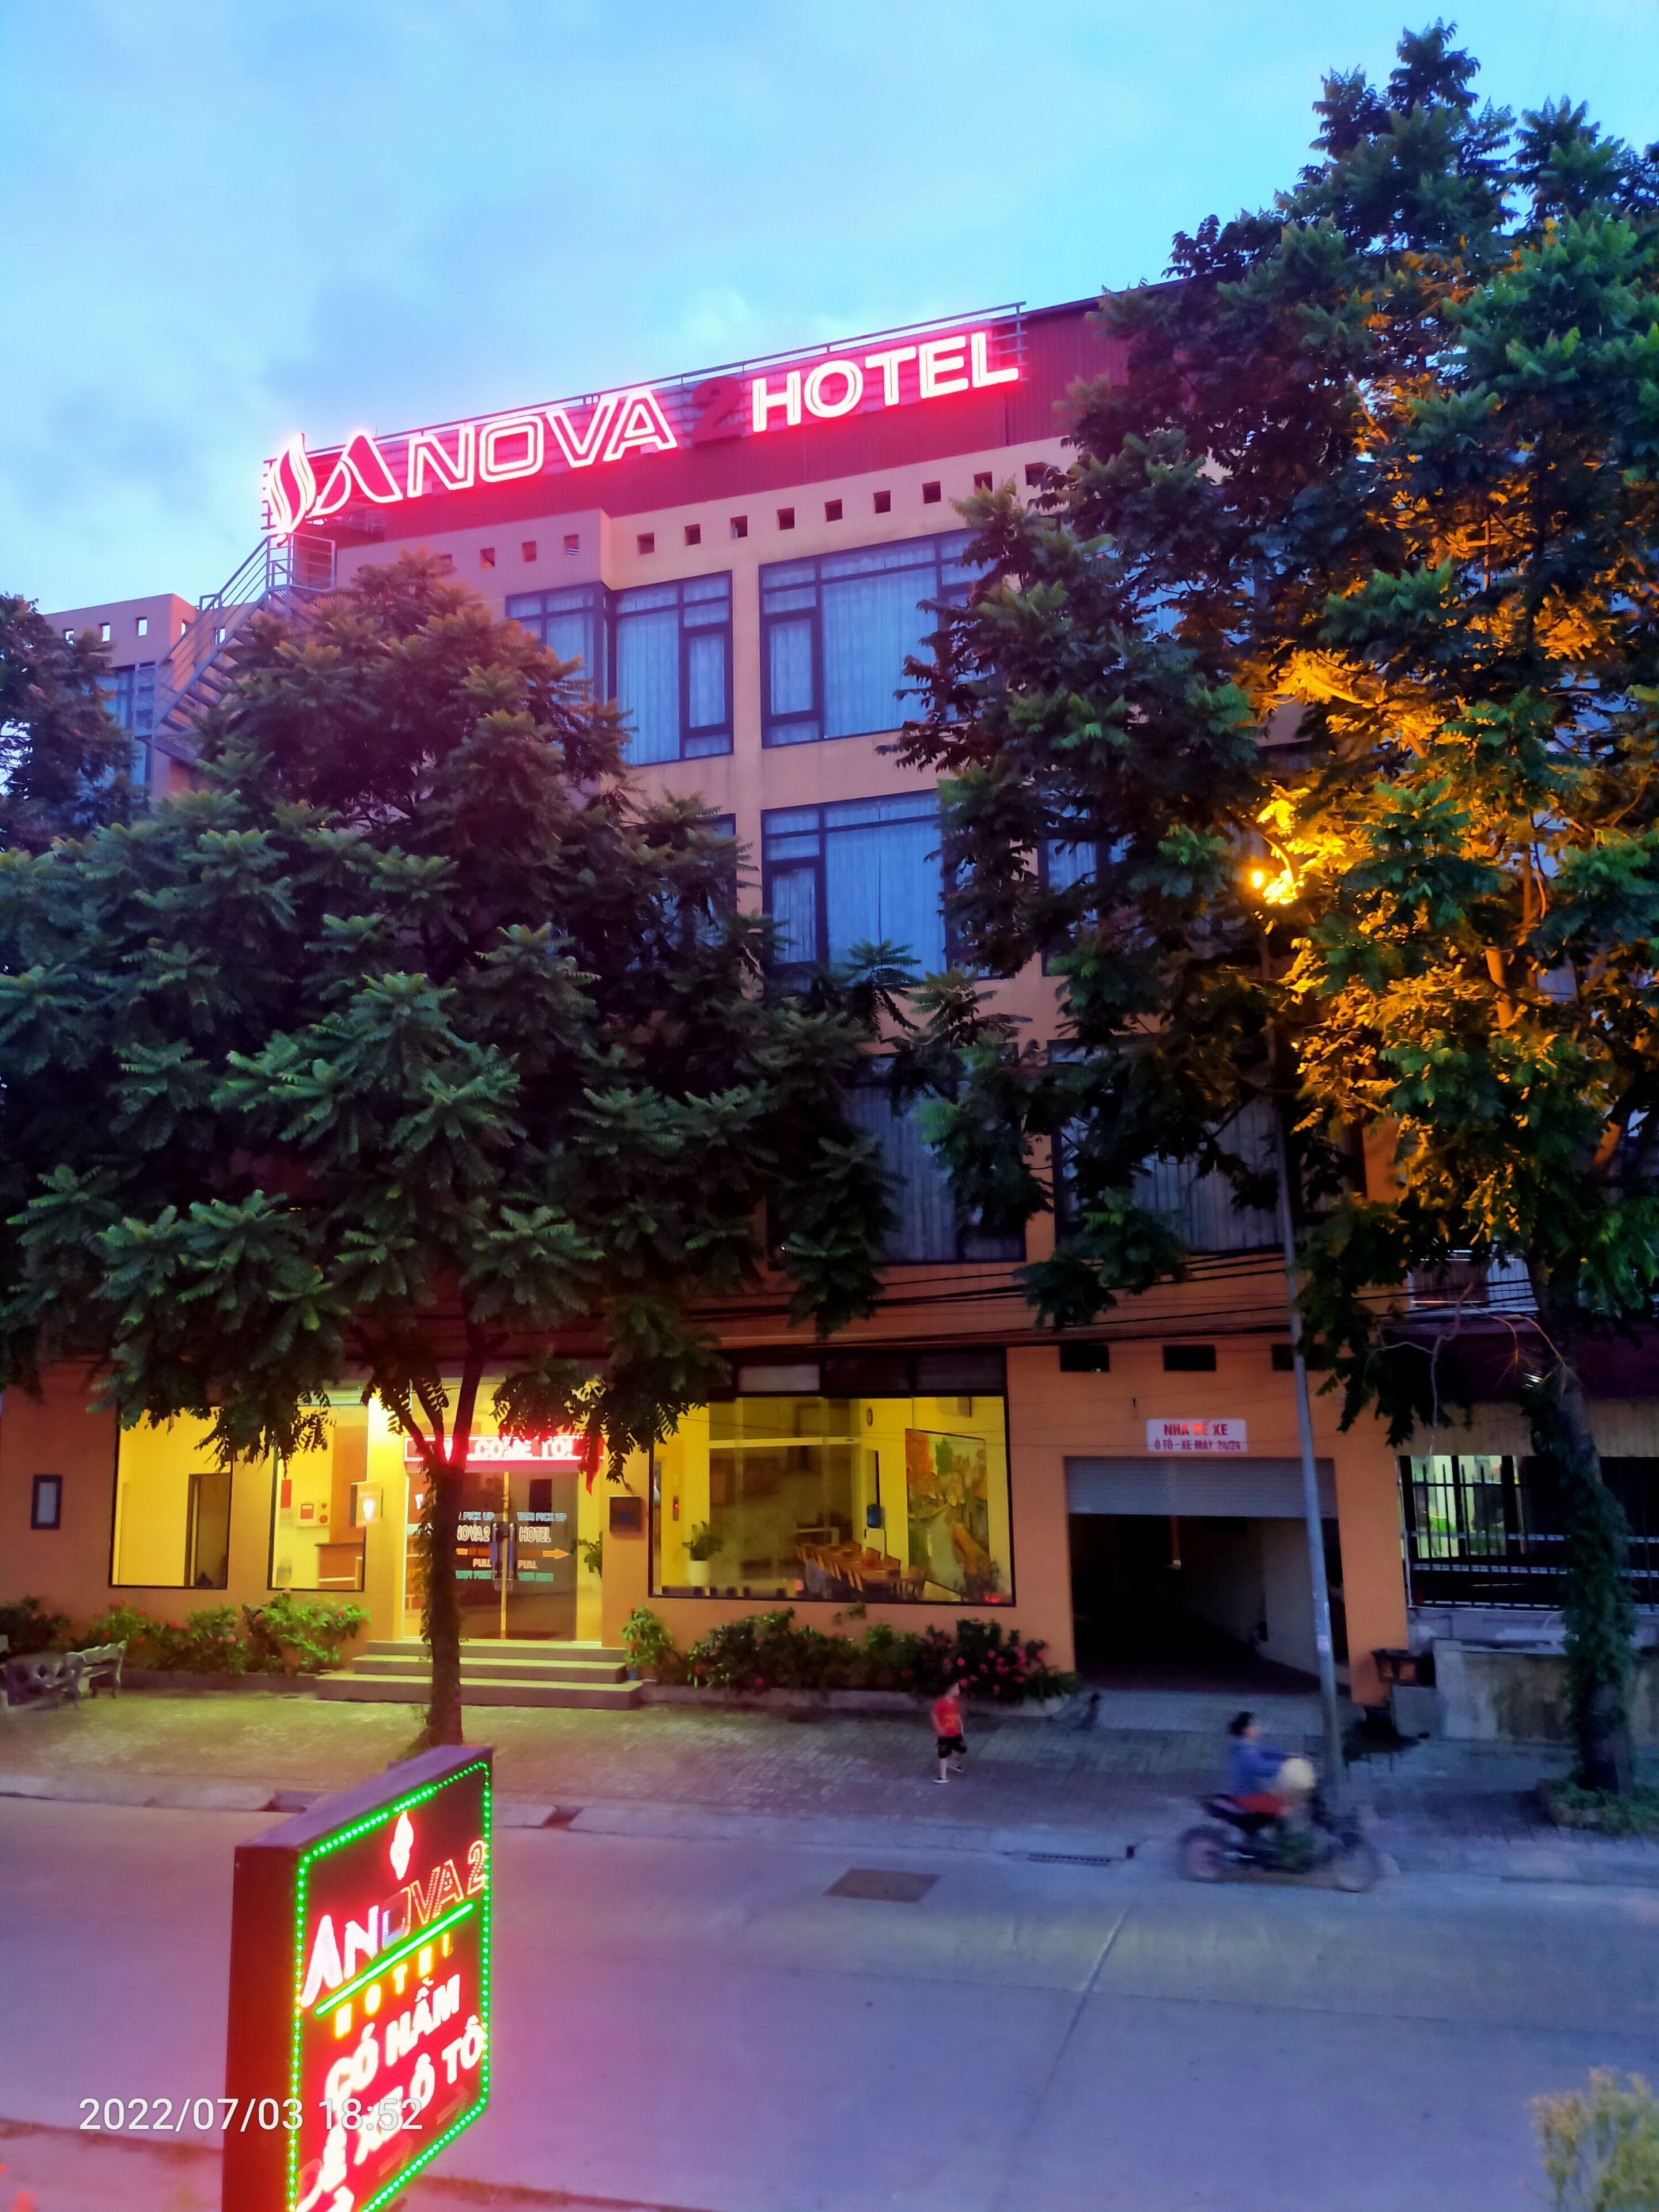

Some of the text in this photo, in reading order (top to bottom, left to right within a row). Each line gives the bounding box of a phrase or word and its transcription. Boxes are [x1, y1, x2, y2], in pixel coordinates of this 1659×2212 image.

[312, 332, 1019, 516] ANOVA 2 HOTEL
[1213, 1423, 1228, 1436] XE
[483, 1512, 495, 1521] UP
[519, 1527, 551, 1543] HOTEL
[555, 1512, 567, 1522] UP
[300, 1839, 487, 2008] ANOVA 2
[325, 1974, 460, 2106] CÓ HẦM
[410, 2053, 435, 2111] Ô
[442, 2014, 486, 2085] TÔ
